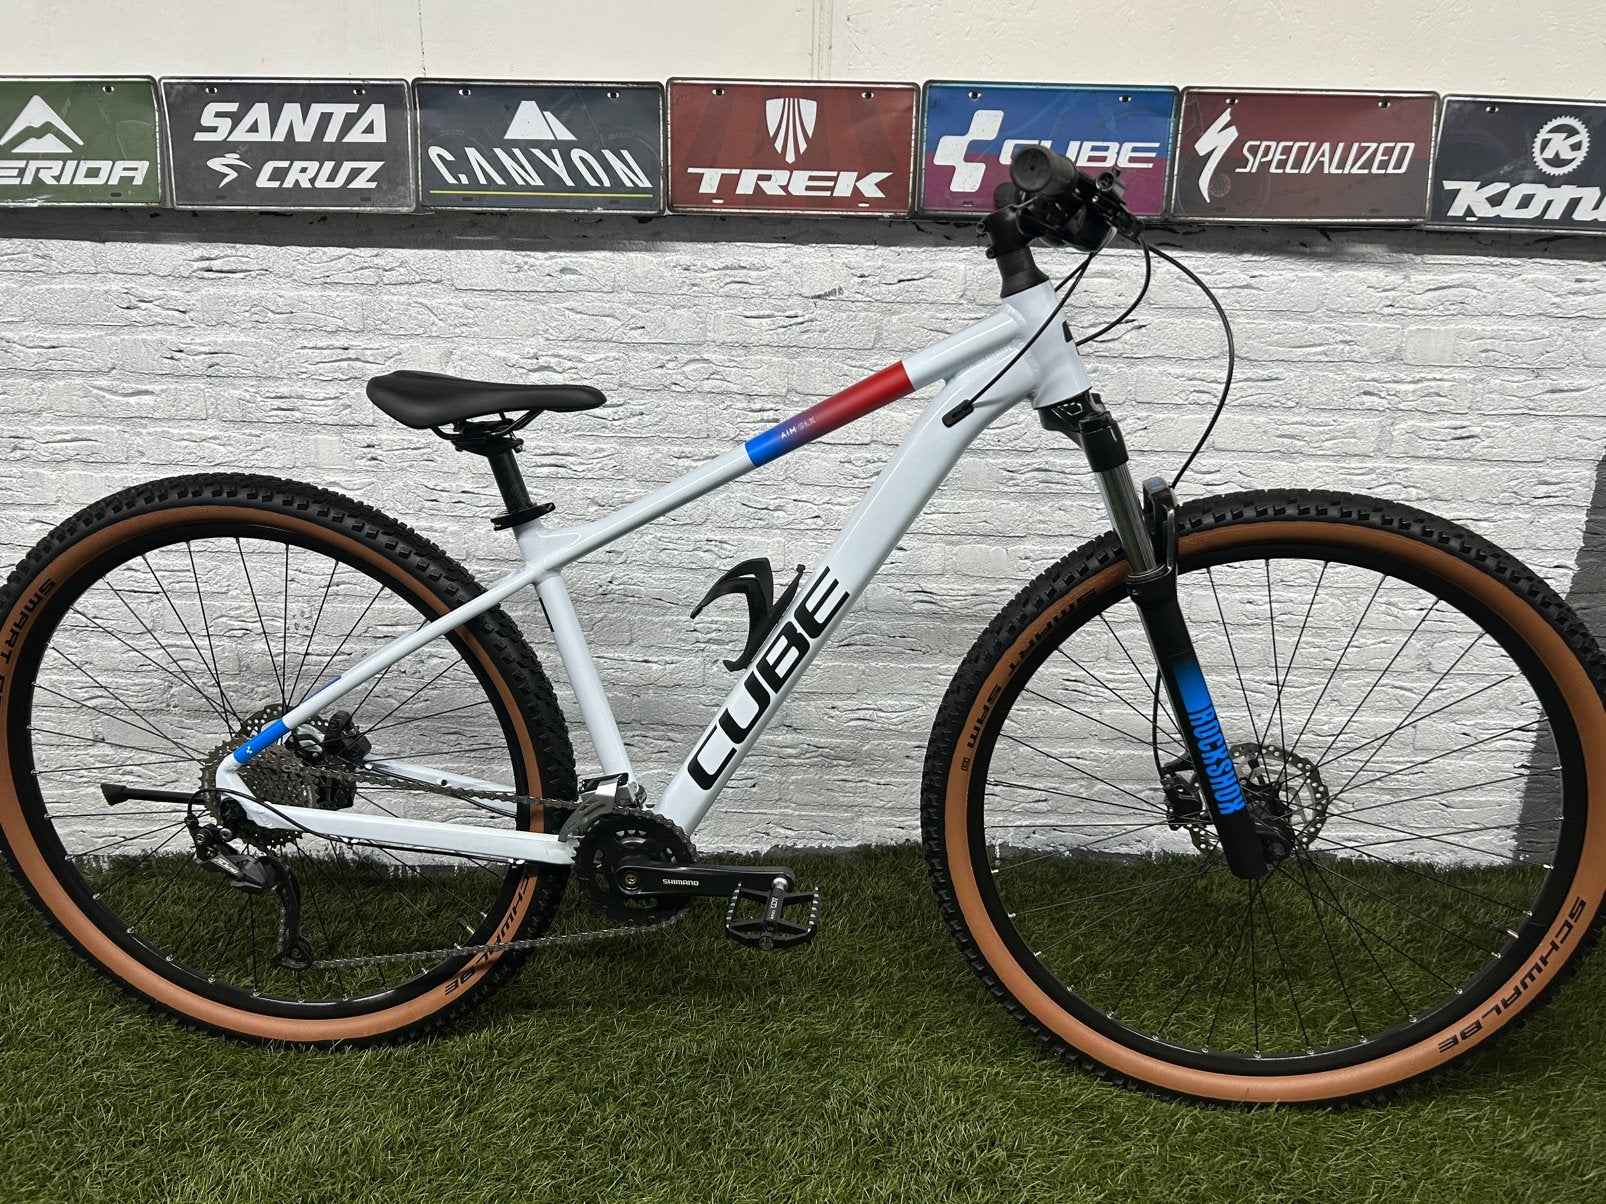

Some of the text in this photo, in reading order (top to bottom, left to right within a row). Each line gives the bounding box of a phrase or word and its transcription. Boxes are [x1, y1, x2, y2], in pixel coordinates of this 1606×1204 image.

[193, 102, 387, 143] SANTA
[255, 160, 386, 189] CRUZ
[428, 145, 653, 188] CANYON
[1235, 139, 1416, 175] SPECIALIZED
[687, 167, 893, 198] TREK
[1442, 180, 1606, 222] KON
[781, 426, 797, 440] AIM
[1, 578, 56, 665] SMART
[687, 565, 851, 791] CUBE
[1188, 703, 1247, 816] ROCKSHOX
[662, 878, 700, 887] SHIMANO
[1438, 896, 1587, 1053] SCHWALBE
